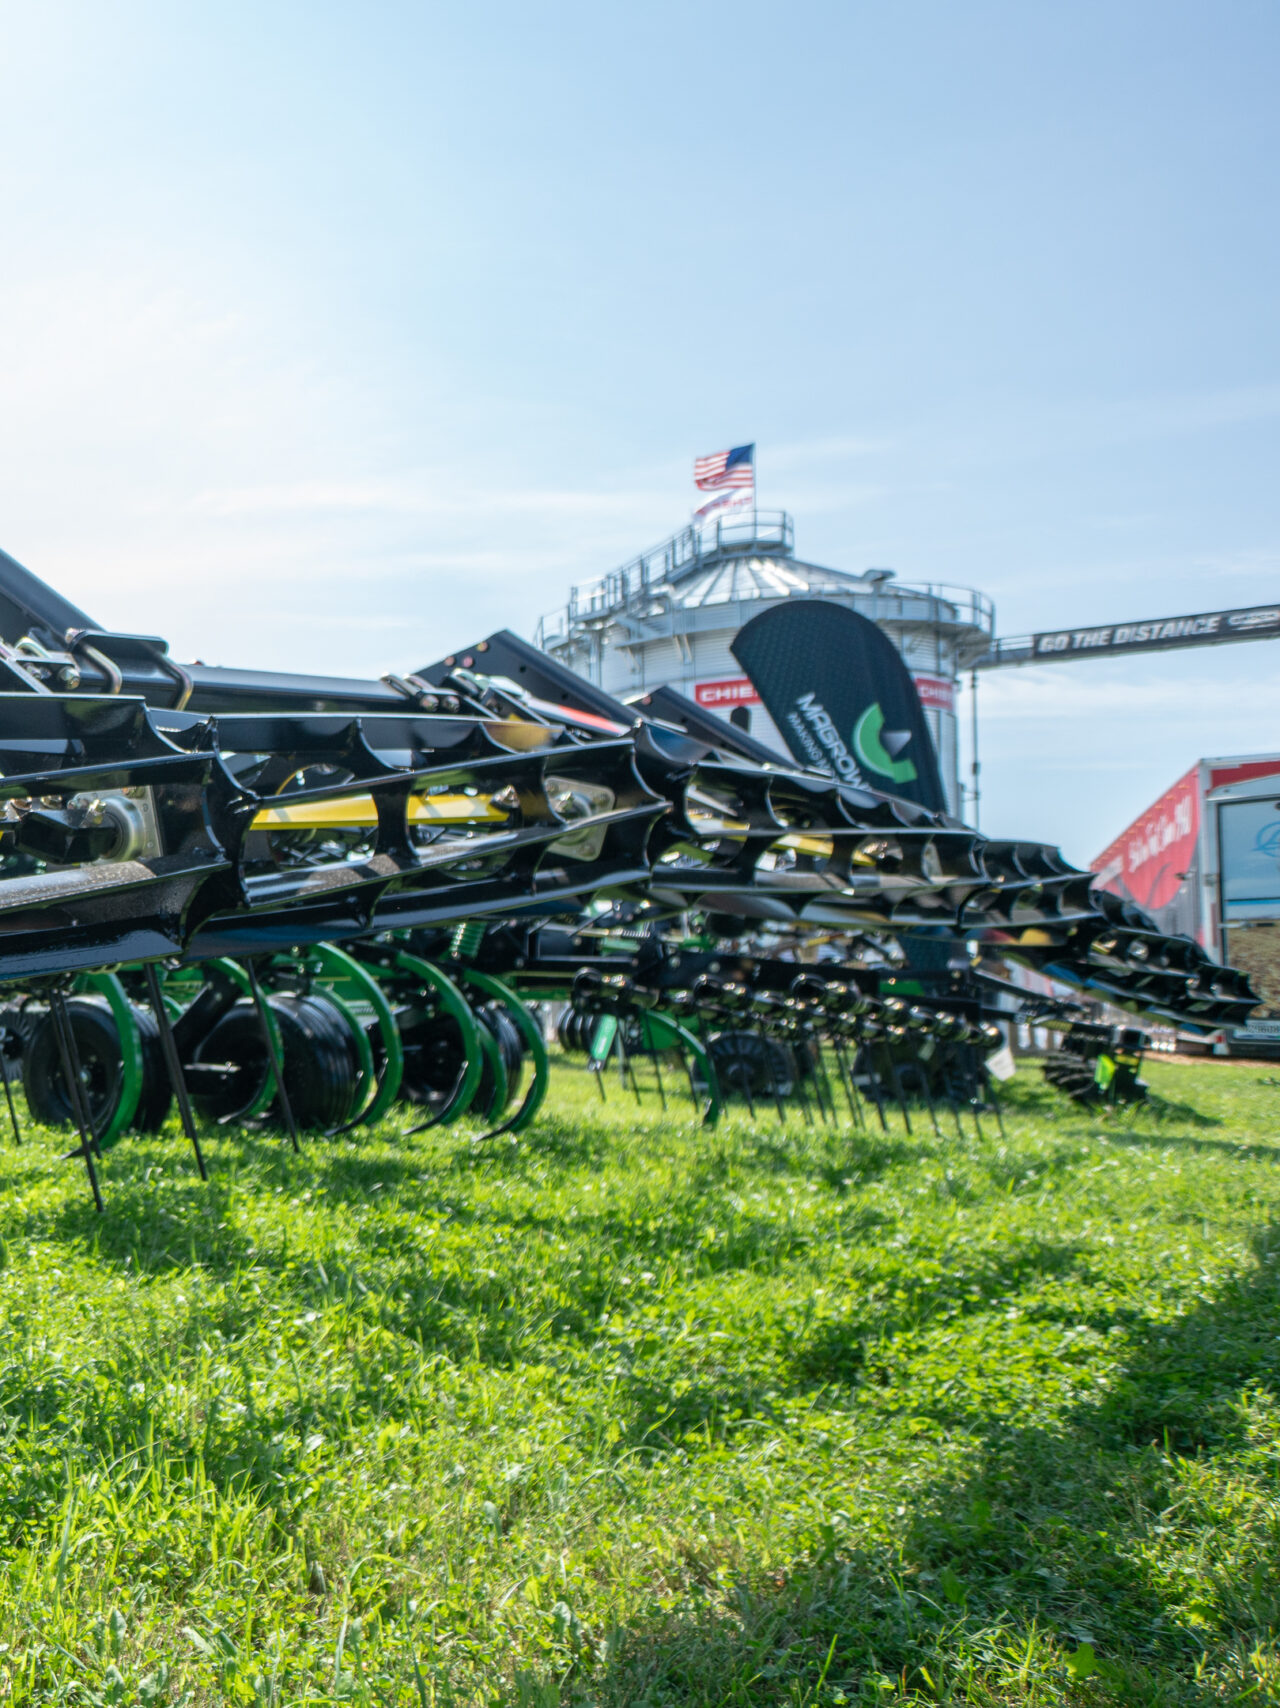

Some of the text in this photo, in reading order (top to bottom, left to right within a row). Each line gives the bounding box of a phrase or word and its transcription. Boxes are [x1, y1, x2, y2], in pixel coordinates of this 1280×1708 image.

[1038, 633, 1070, 653] GO
[1072, 629, 1111, 649] THE
[1112, 616, 1221, 645] DISTANCE
[787, 711, 823, 763] MAKING
